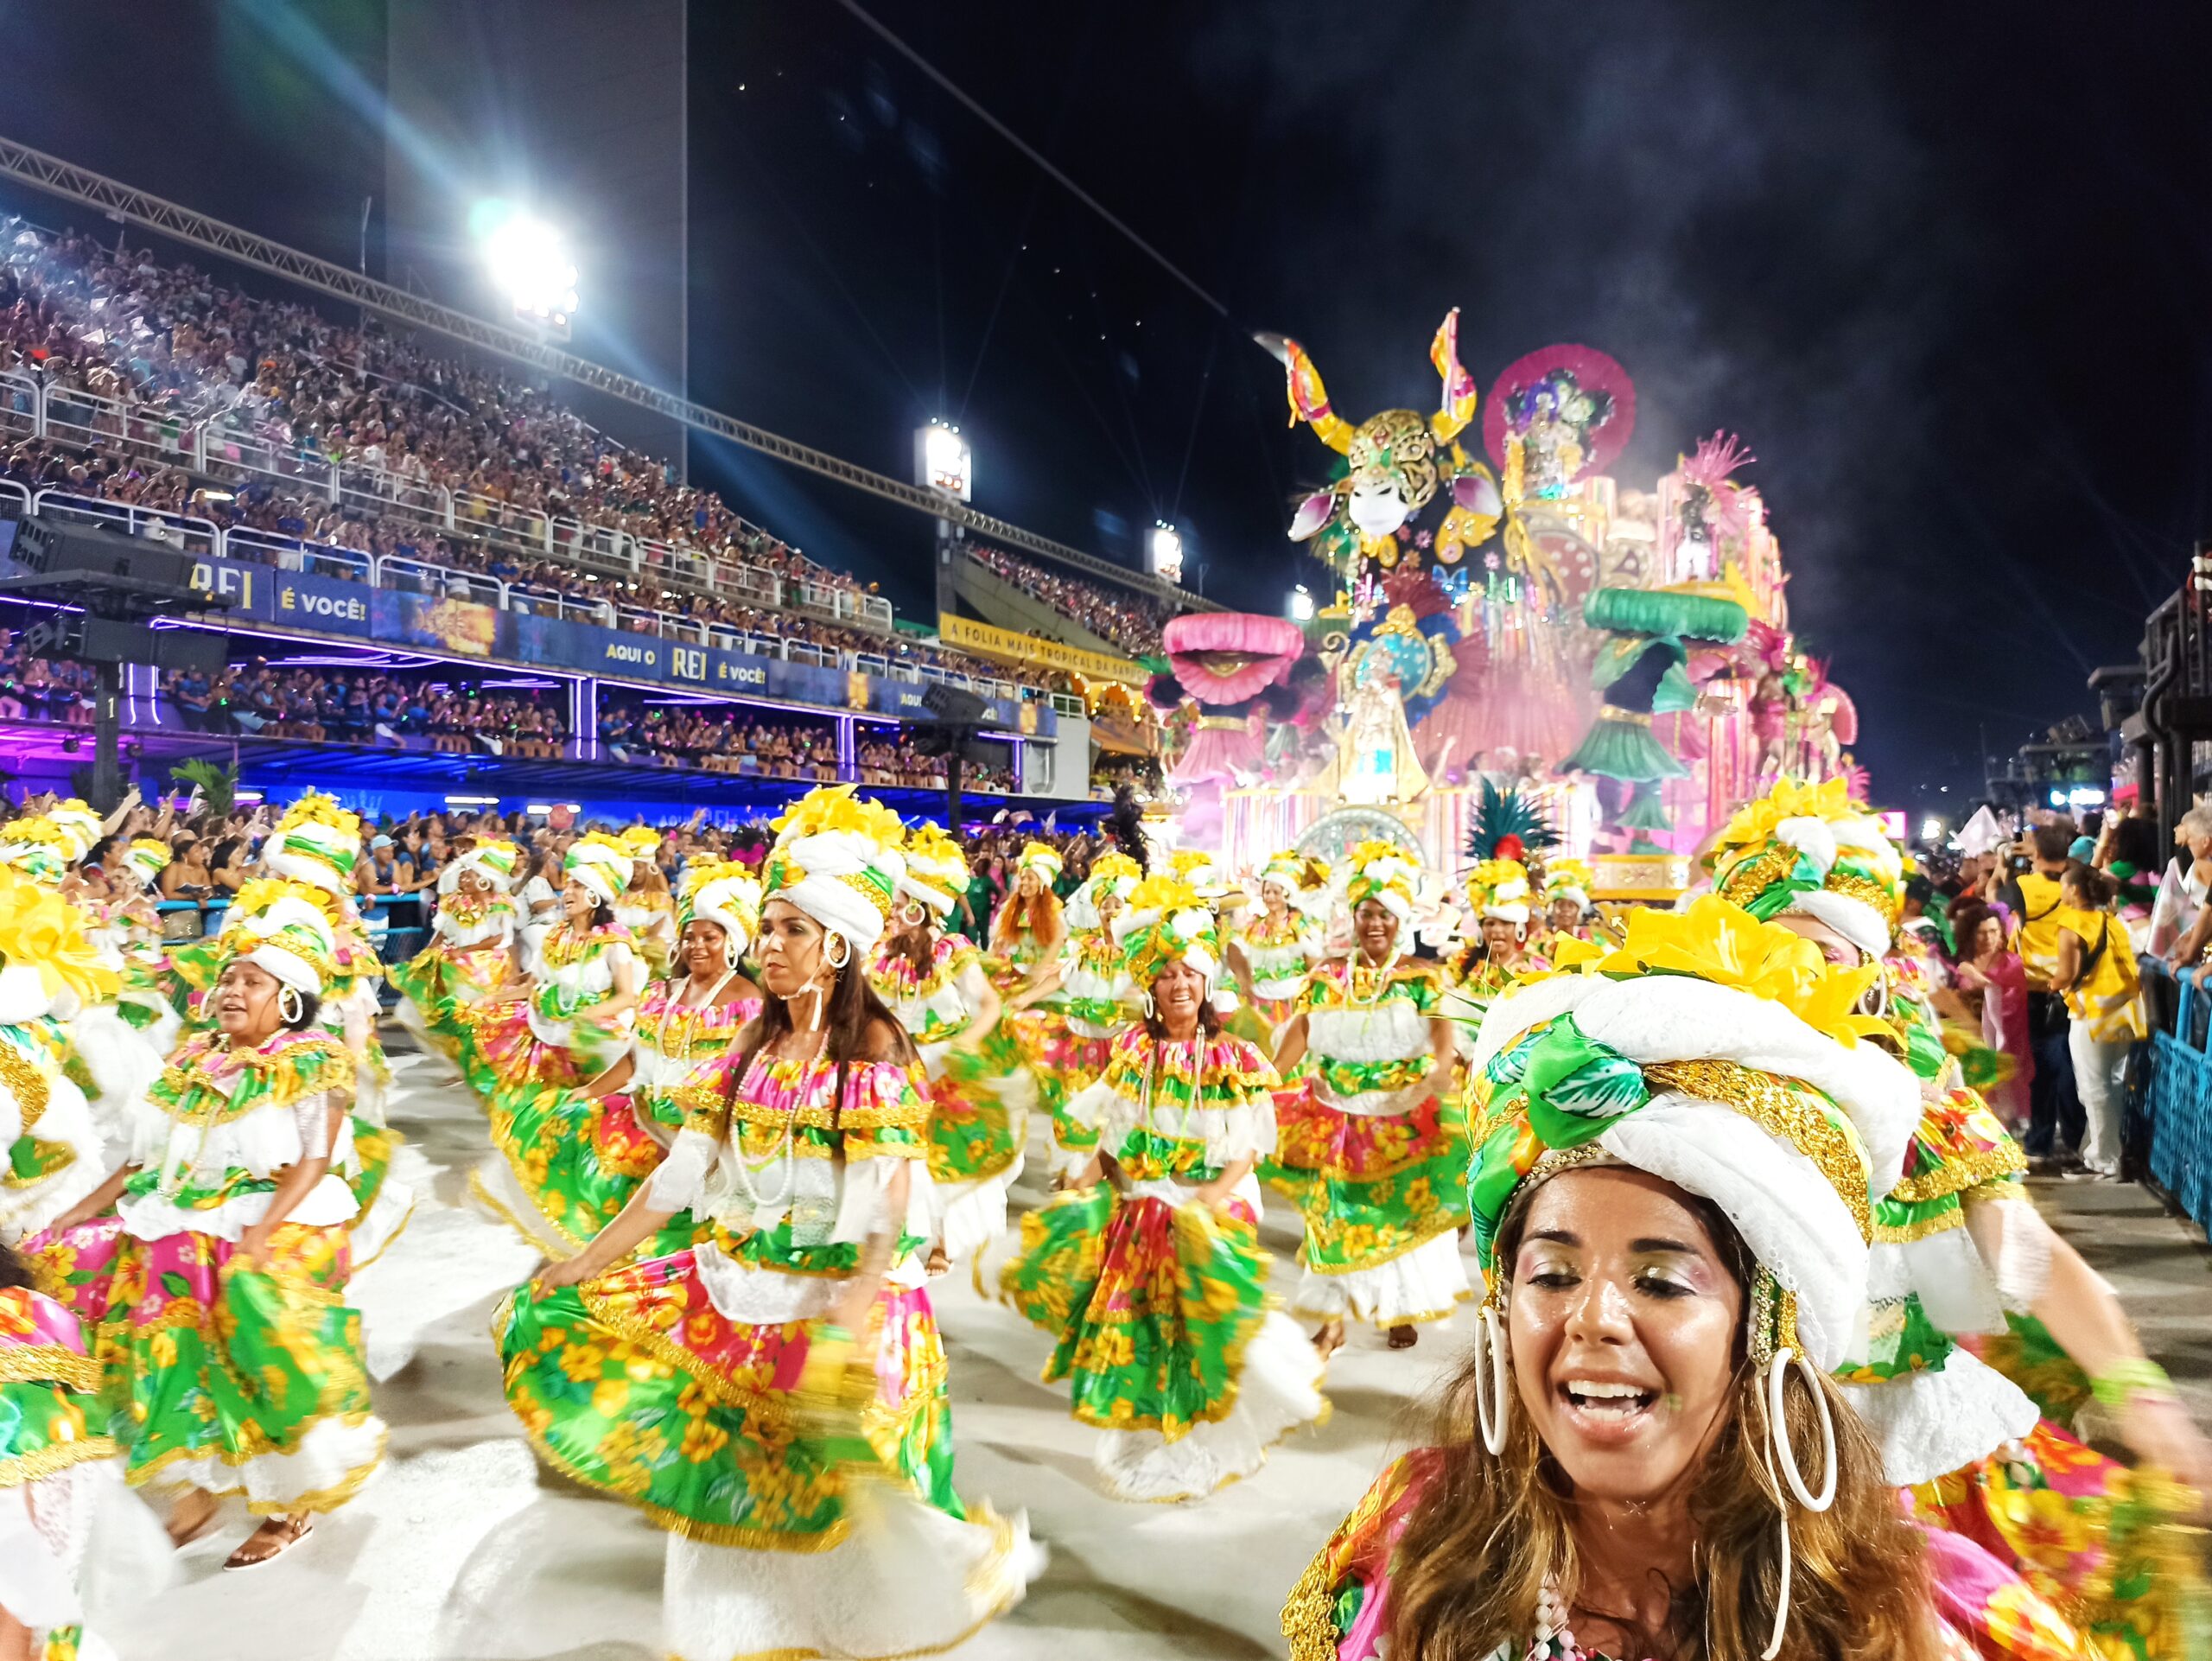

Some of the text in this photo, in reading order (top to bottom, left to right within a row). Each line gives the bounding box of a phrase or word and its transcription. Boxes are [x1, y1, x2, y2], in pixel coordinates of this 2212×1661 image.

[282, 586, 296, 610] É
[302, 593, 366, 620] VOCÊ!
[606, 643, 766, 684] AQUI O REI É VOCÊ!
[952, 622, 958, 637] A
[965, 627, 1001, 647] FOLIA
[1007, 637, 1035, 655] MAIS
[1040, 646, 1091, 669] TROPICAL
[1096, 659, 1109, 671] DA
[108, 697, 114, 718] 1
